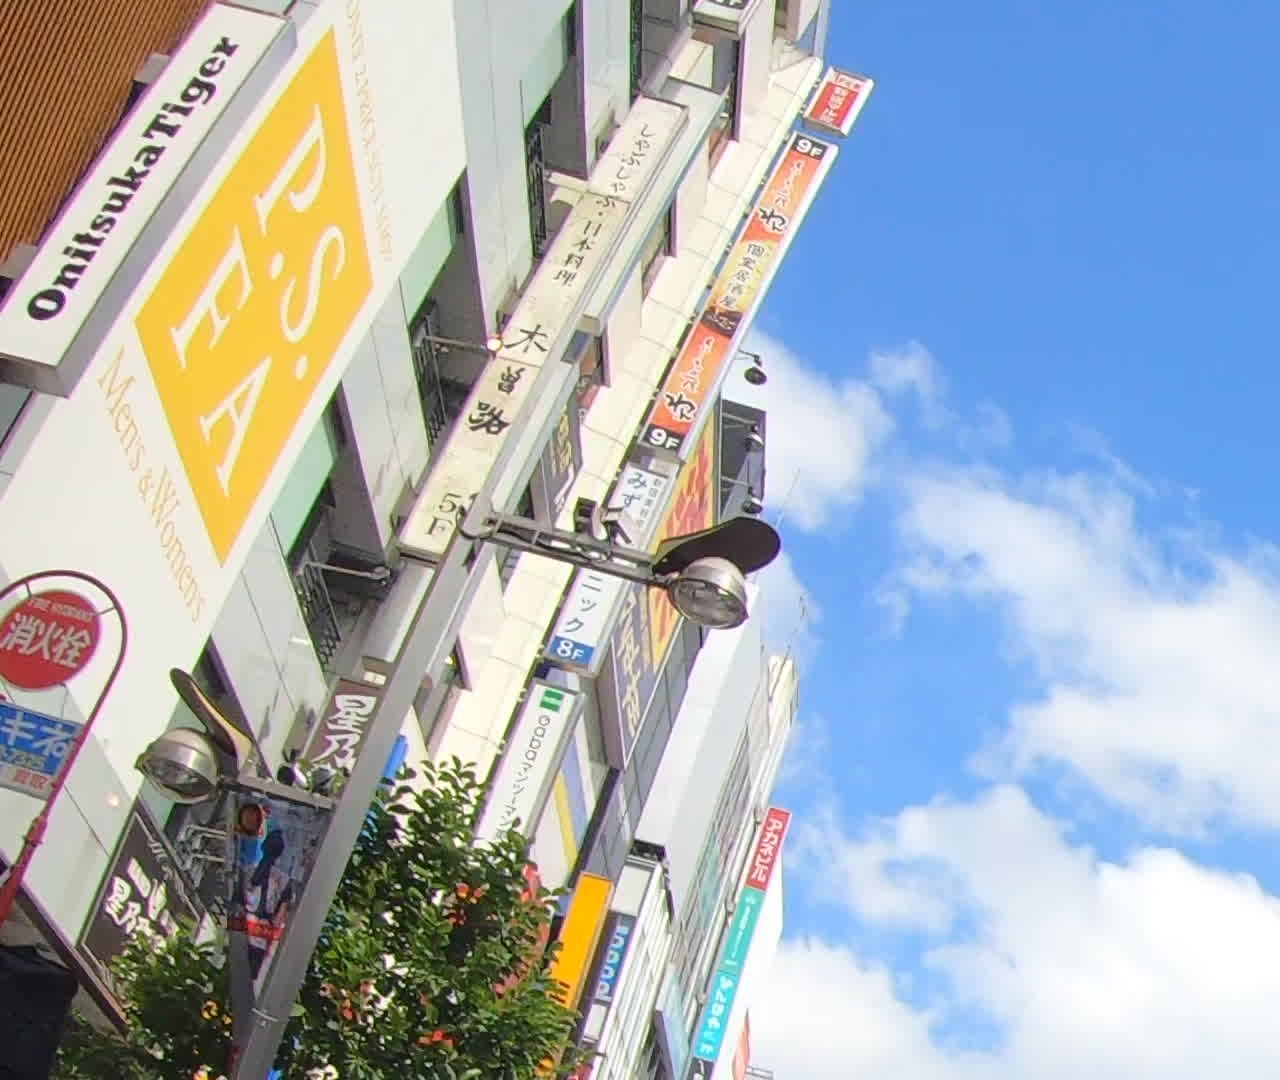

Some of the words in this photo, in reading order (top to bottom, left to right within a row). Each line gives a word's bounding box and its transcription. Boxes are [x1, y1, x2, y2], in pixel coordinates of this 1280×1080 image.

[795, 138, 824, 161] 9F
[27, 144, 167, 321] Onitsuka
[141, 36, 240, 140] Tiger
[648, 427, 681, 449] 9F
[0, 612, 93, 670] 消火栓
[553, 639, 585, 662] 8F
